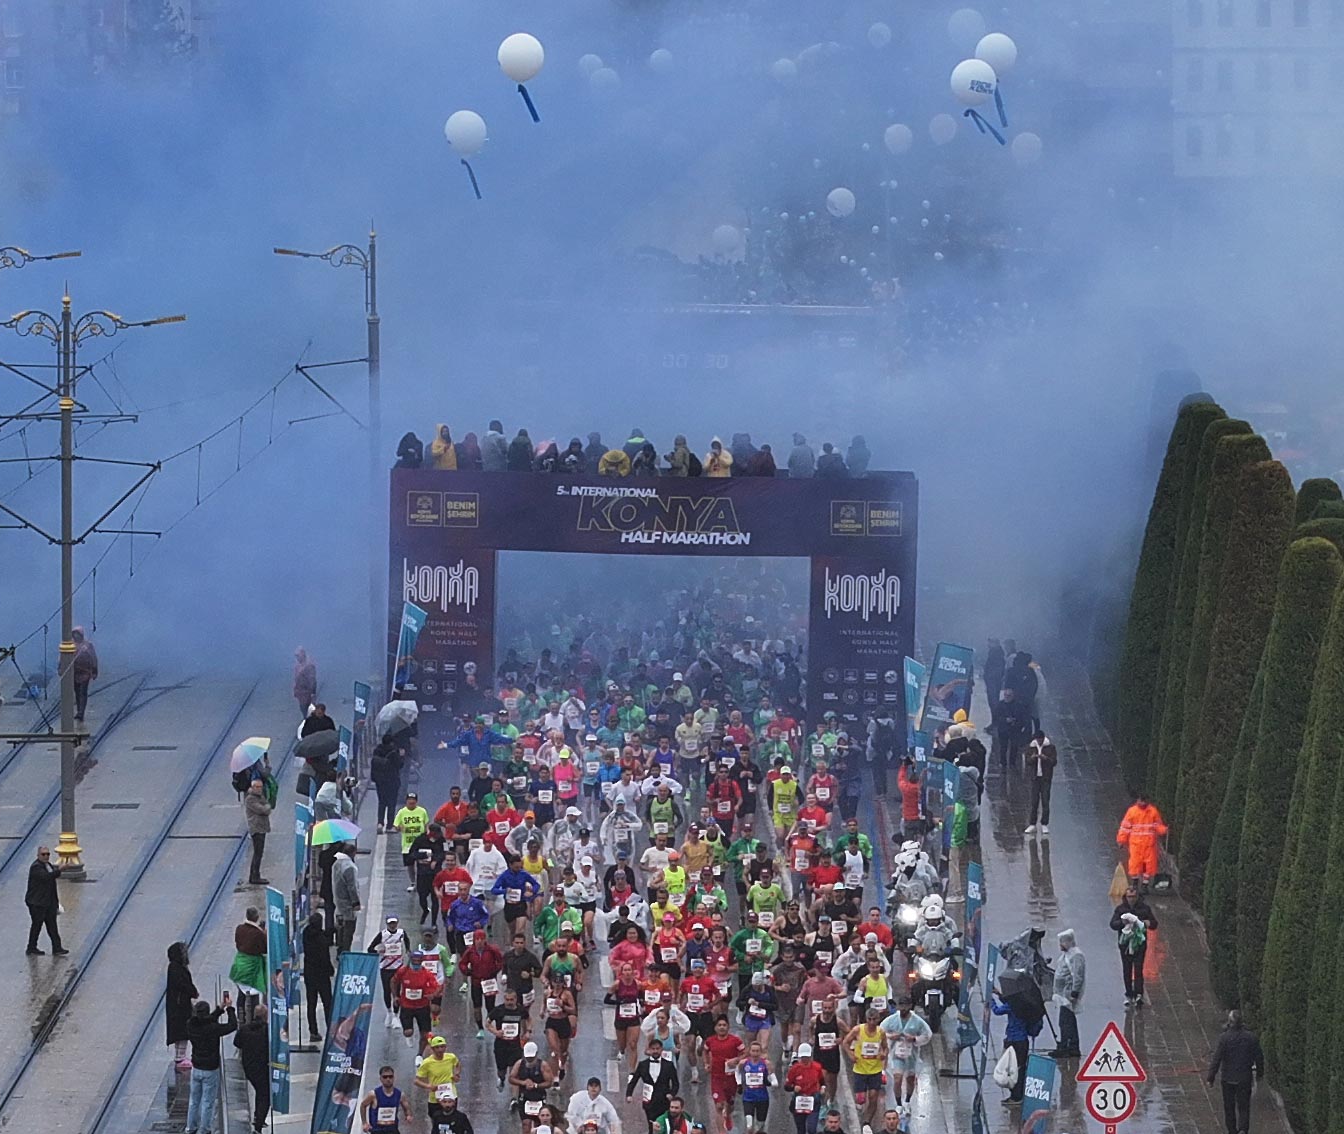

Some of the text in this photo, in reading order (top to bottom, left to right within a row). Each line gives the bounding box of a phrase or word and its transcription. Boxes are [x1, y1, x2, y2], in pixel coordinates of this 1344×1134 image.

[571, 487, 658, 497] INTERNATIONAL
[577, 496, 740, 532] KONYA
[621, 531, 750, 544] HALF MARATHON
[1095, 1088, 1126, 1110] 30
